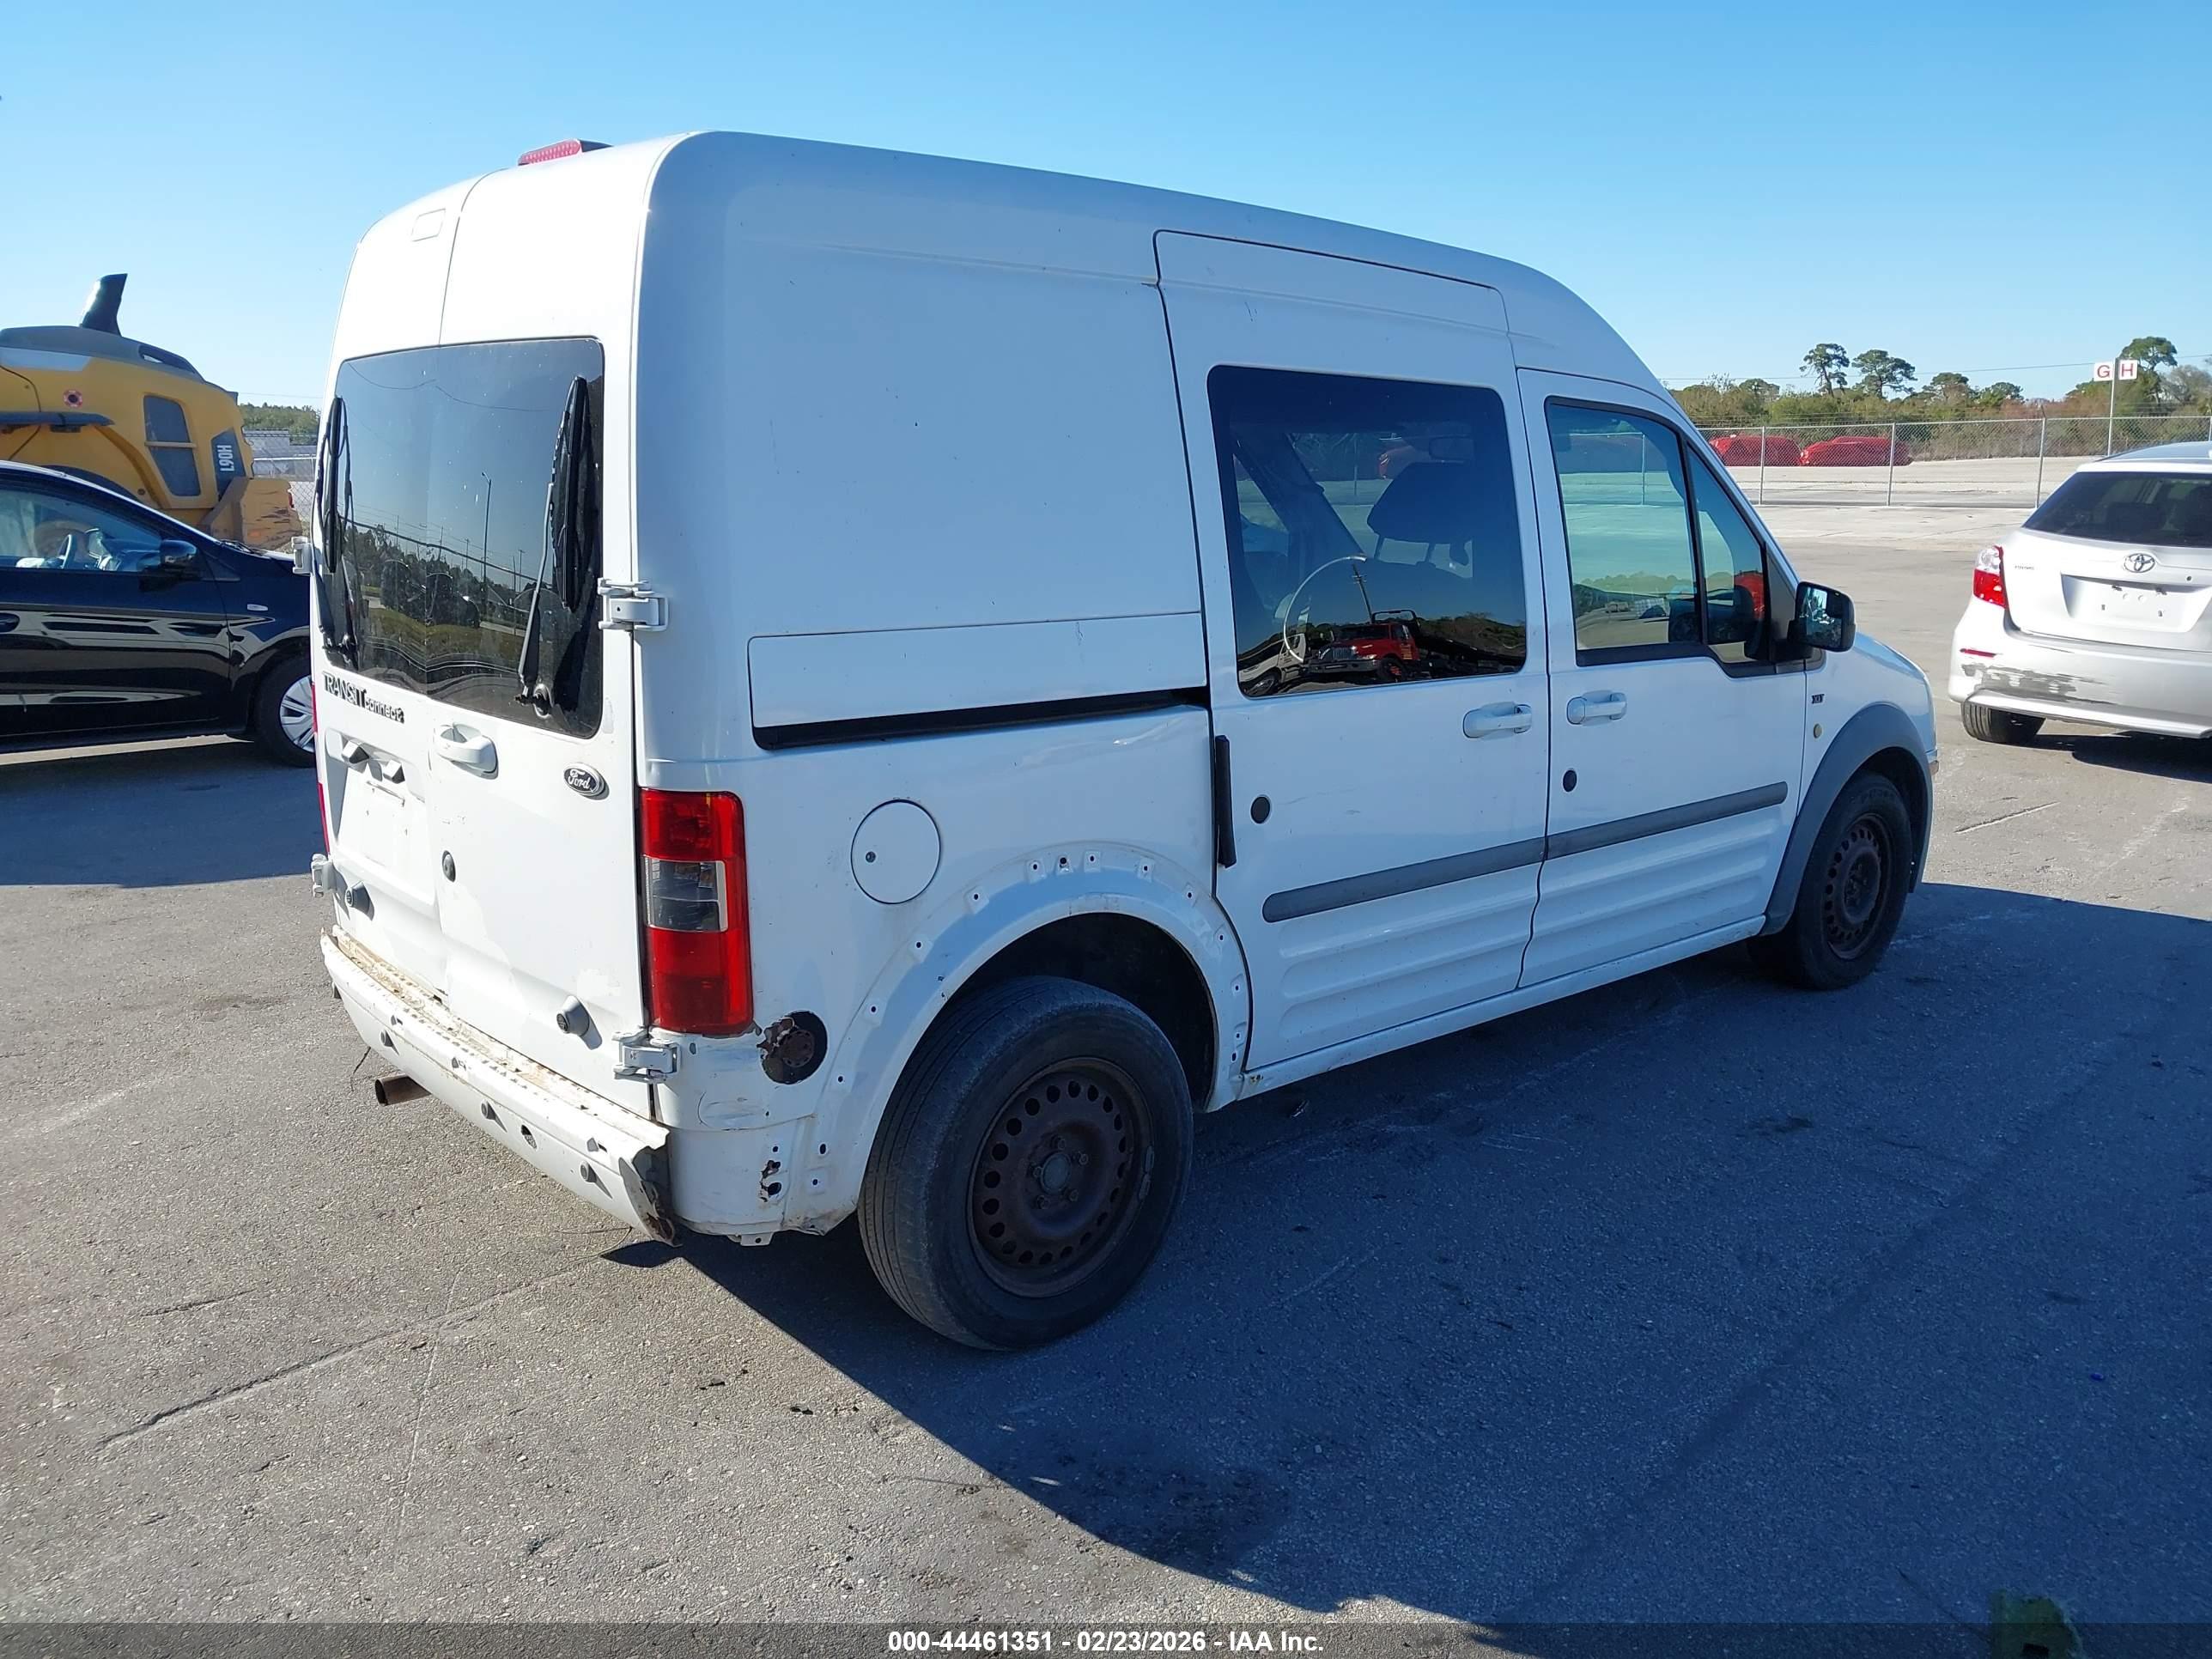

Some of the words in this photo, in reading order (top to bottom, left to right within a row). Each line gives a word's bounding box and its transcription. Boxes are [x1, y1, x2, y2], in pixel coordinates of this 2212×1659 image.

[2097, 365, 2111, 379] G
[2121, 363, 2134, 377] H
[216, 445, 235, 472] L90H
[568, 769, 591, 790] Ford
